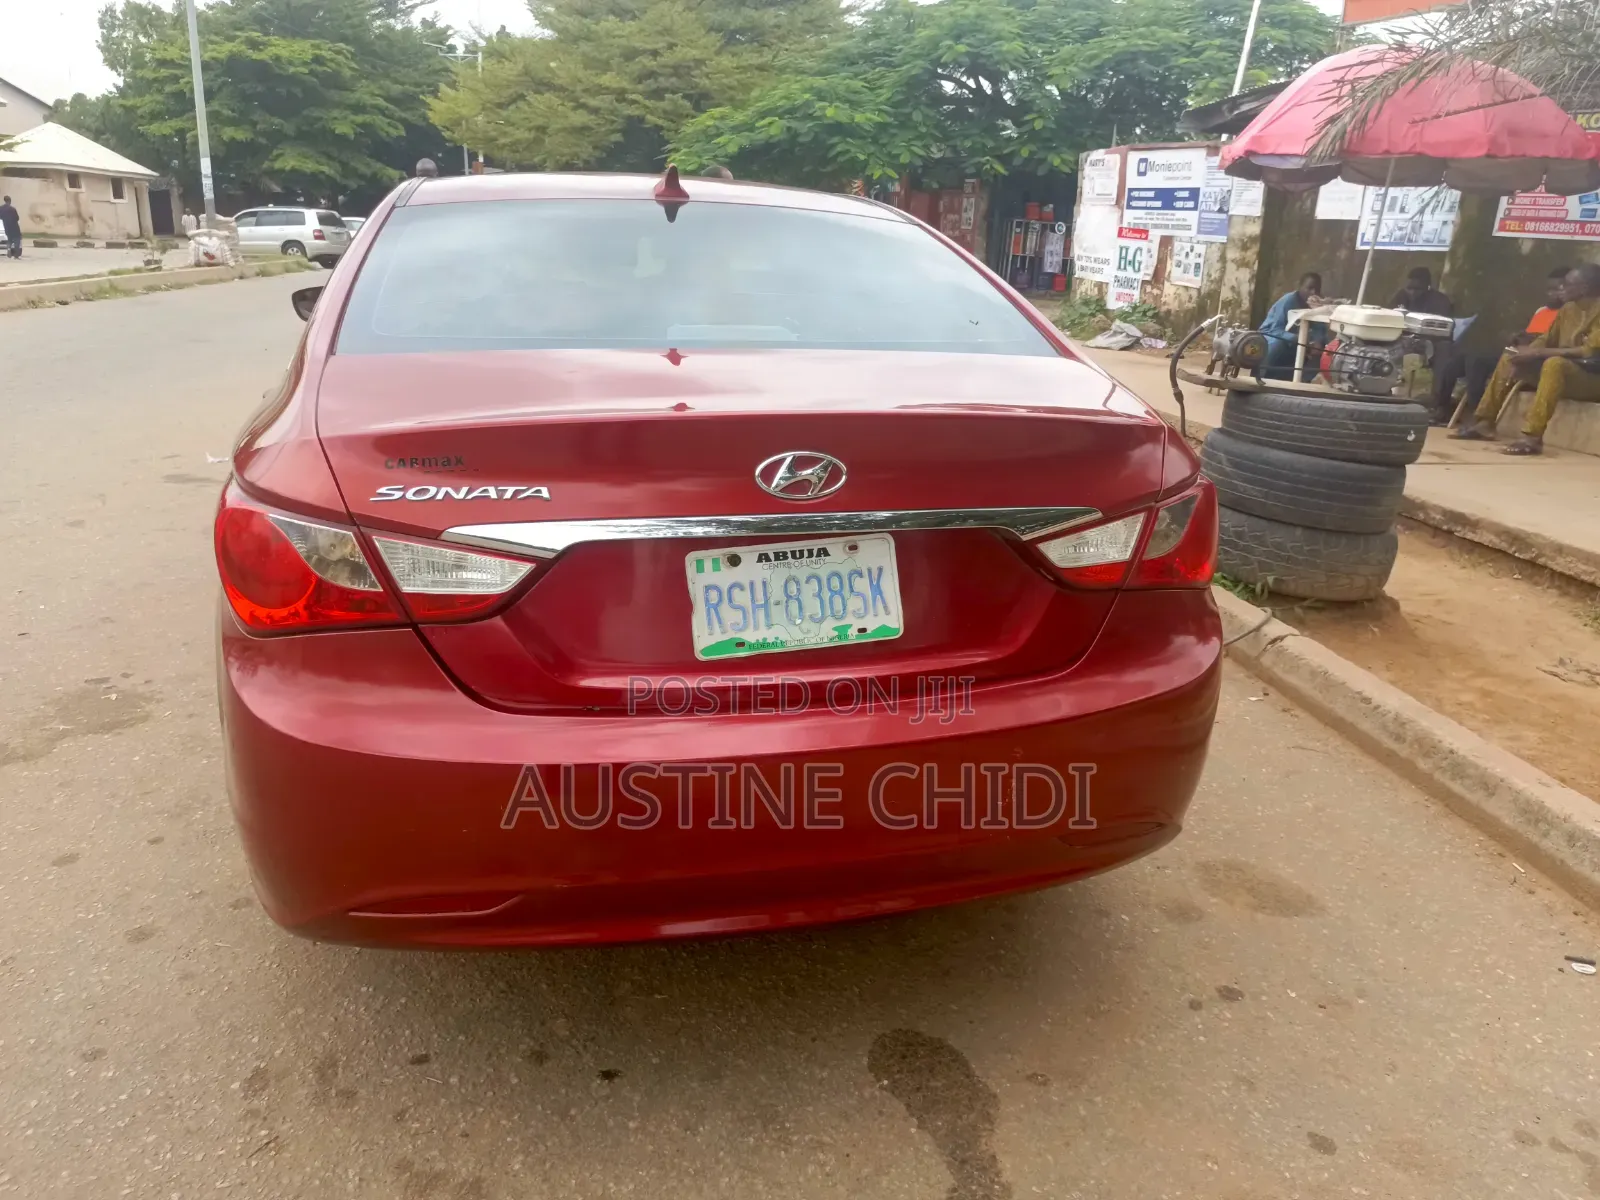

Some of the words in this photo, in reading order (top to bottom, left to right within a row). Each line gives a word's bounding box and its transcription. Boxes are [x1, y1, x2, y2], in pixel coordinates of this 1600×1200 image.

[1148, 160, 1193, 173] Moniepoint
[1514, 196, 1534, 205] MONEY
[1535, 197, 1565, 206] TRANSFER
[1504, 221, 1524, 231] TEL:
[1113, 274, 1140, 291] PHARMACY
[369, 484, 552, 502] SONATA
[756, 546, 831, 564] ABUJA
[761, 561, 792, 571] CENTRE
[805, 557, 827, 568] UNITY
[703, 565, 892, 636] RSH-838SK
[748, 640, 779, 650] FEDERAL
